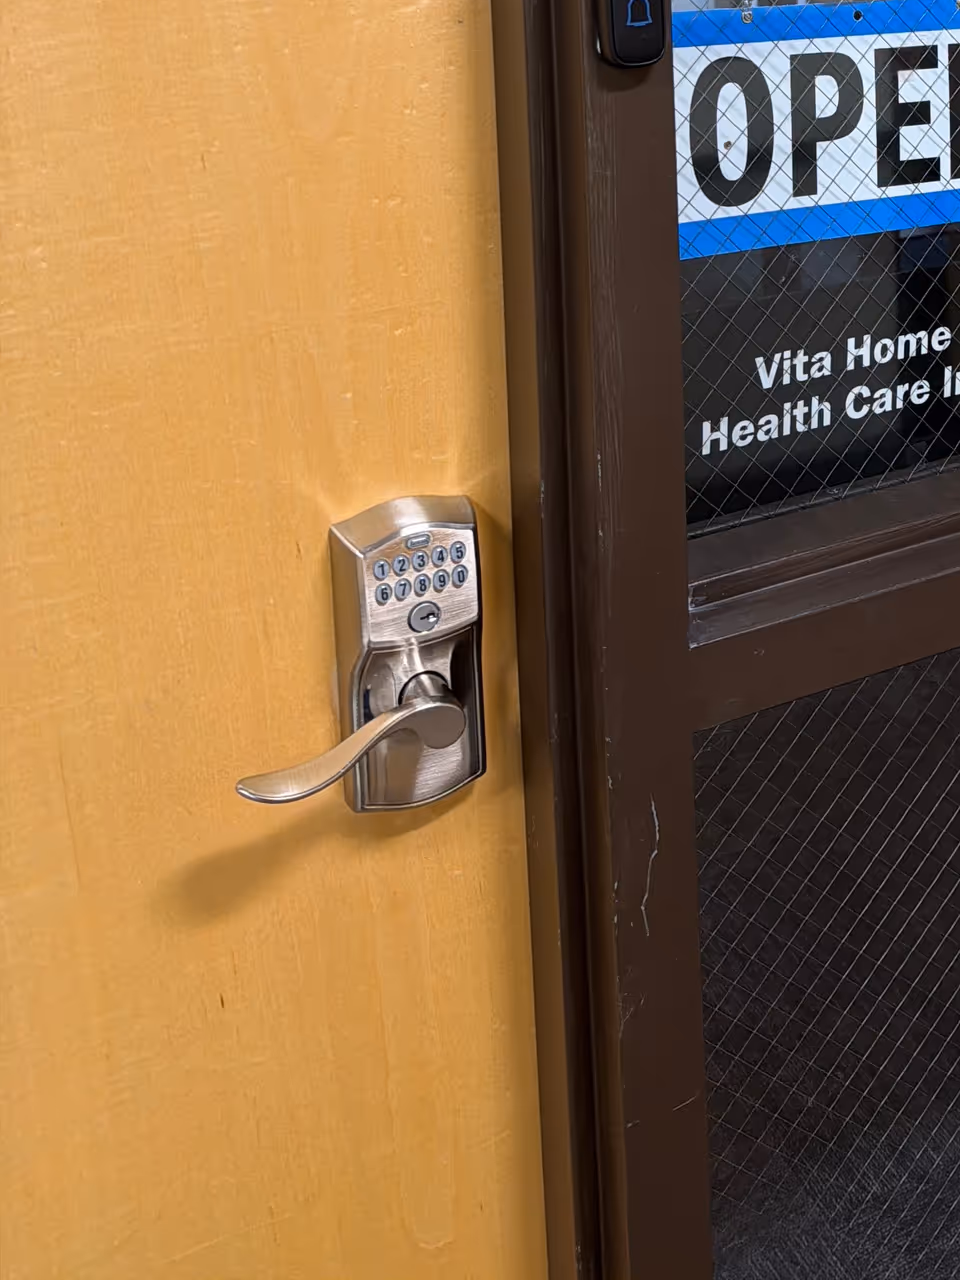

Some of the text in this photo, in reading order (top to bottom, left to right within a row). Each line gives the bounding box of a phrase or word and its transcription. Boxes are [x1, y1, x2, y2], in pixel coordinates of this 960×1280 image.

[754, 326, 952, 390] Vita Home
[701, 395, 832, 456] Health
[845, 378, 931, 420] Care
[377, 546, 464, 577] 1 2 3 4 5
[380, 570, 466, 601] 6 7 8 9 0
